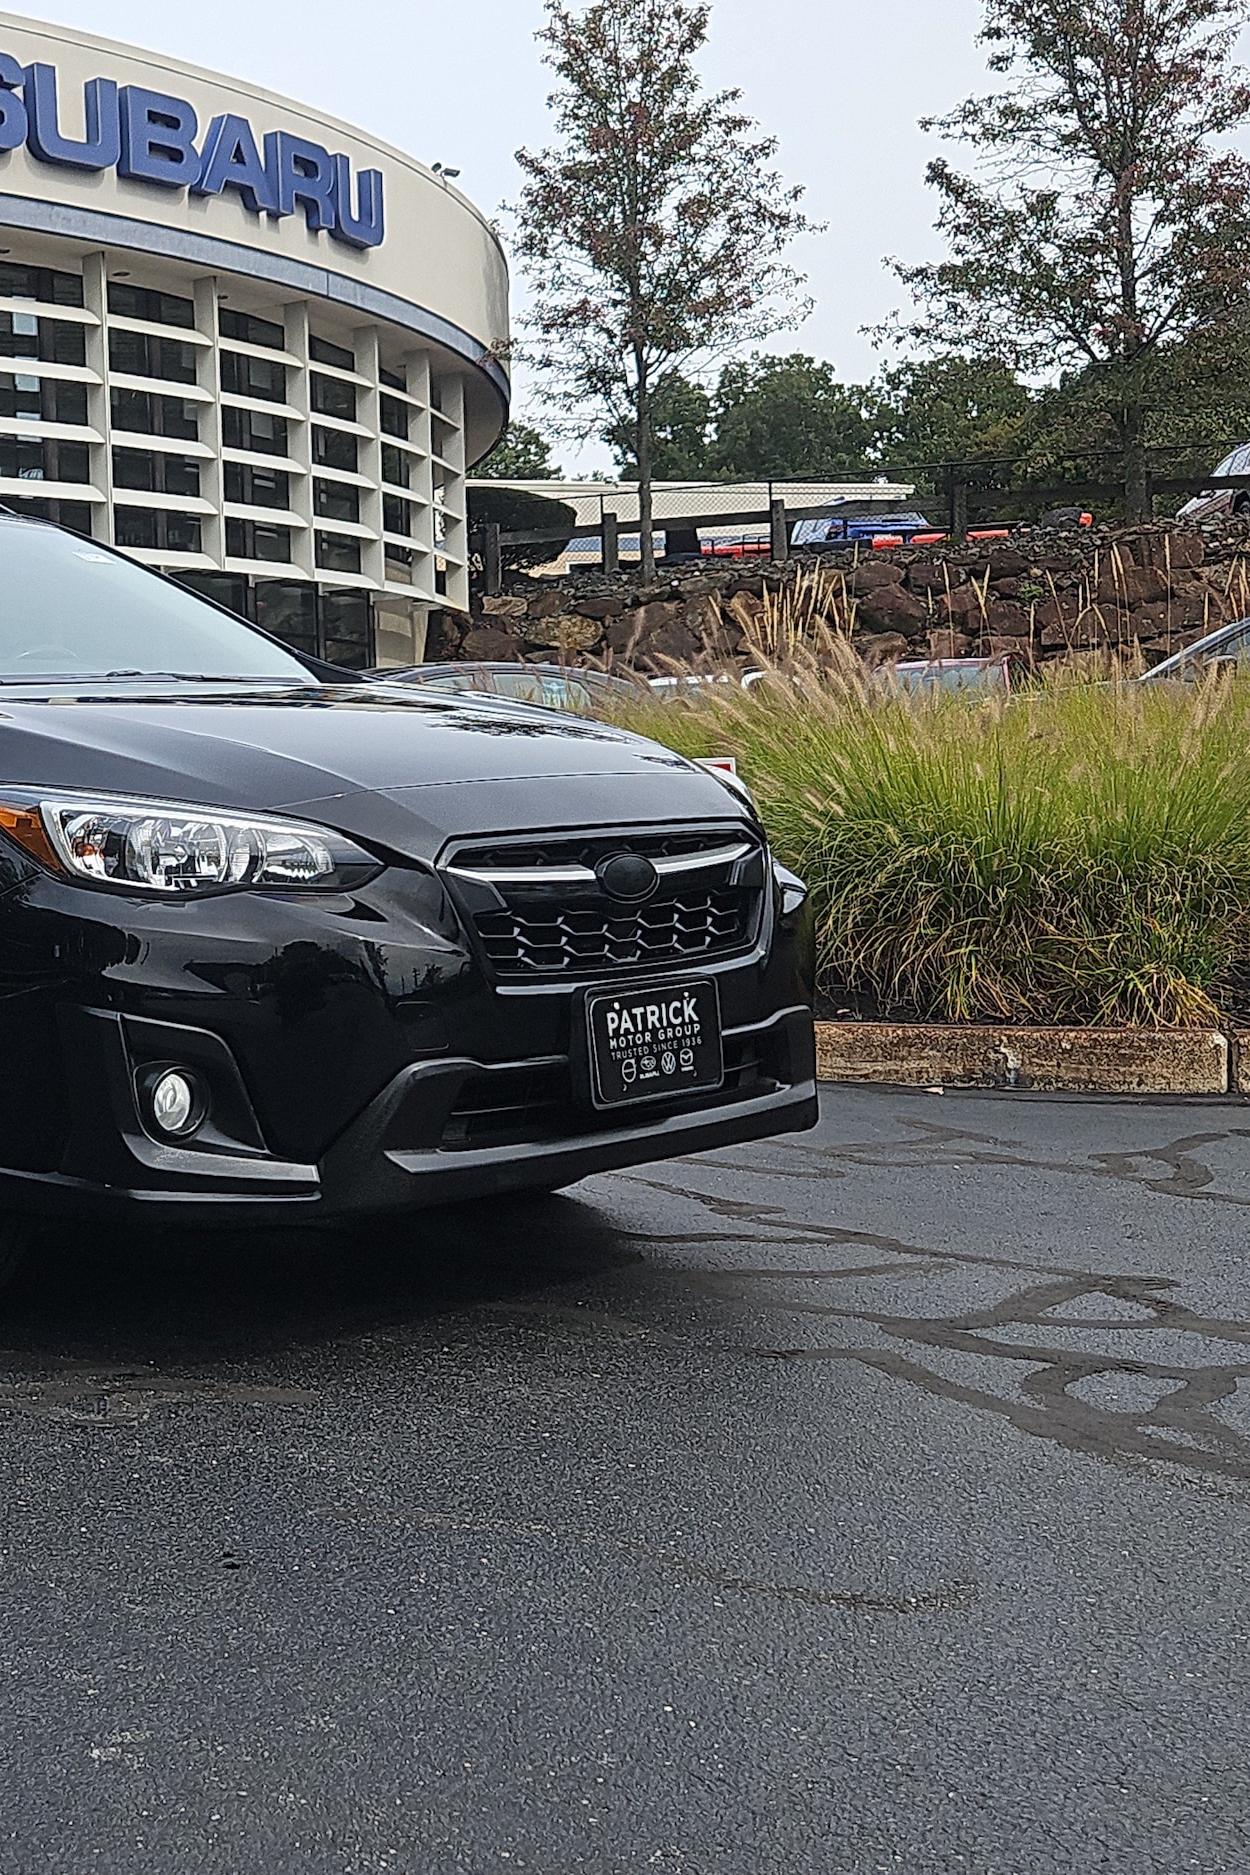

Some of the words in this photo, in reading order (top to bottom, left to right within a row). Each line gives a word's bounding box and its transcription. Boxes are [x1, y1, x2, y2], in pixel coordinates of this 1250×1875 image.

[606, 997, 699, 1037] PATRICK
[609, 1033, 652, 1050] MOTOR
[658, 1023, 701, 1040] GROUP
[611, 1045, 650, 1061] TRUSTED
[653, 1040, 679, 1053] SINCE
[682, 1036, 702, 1048] 1936
